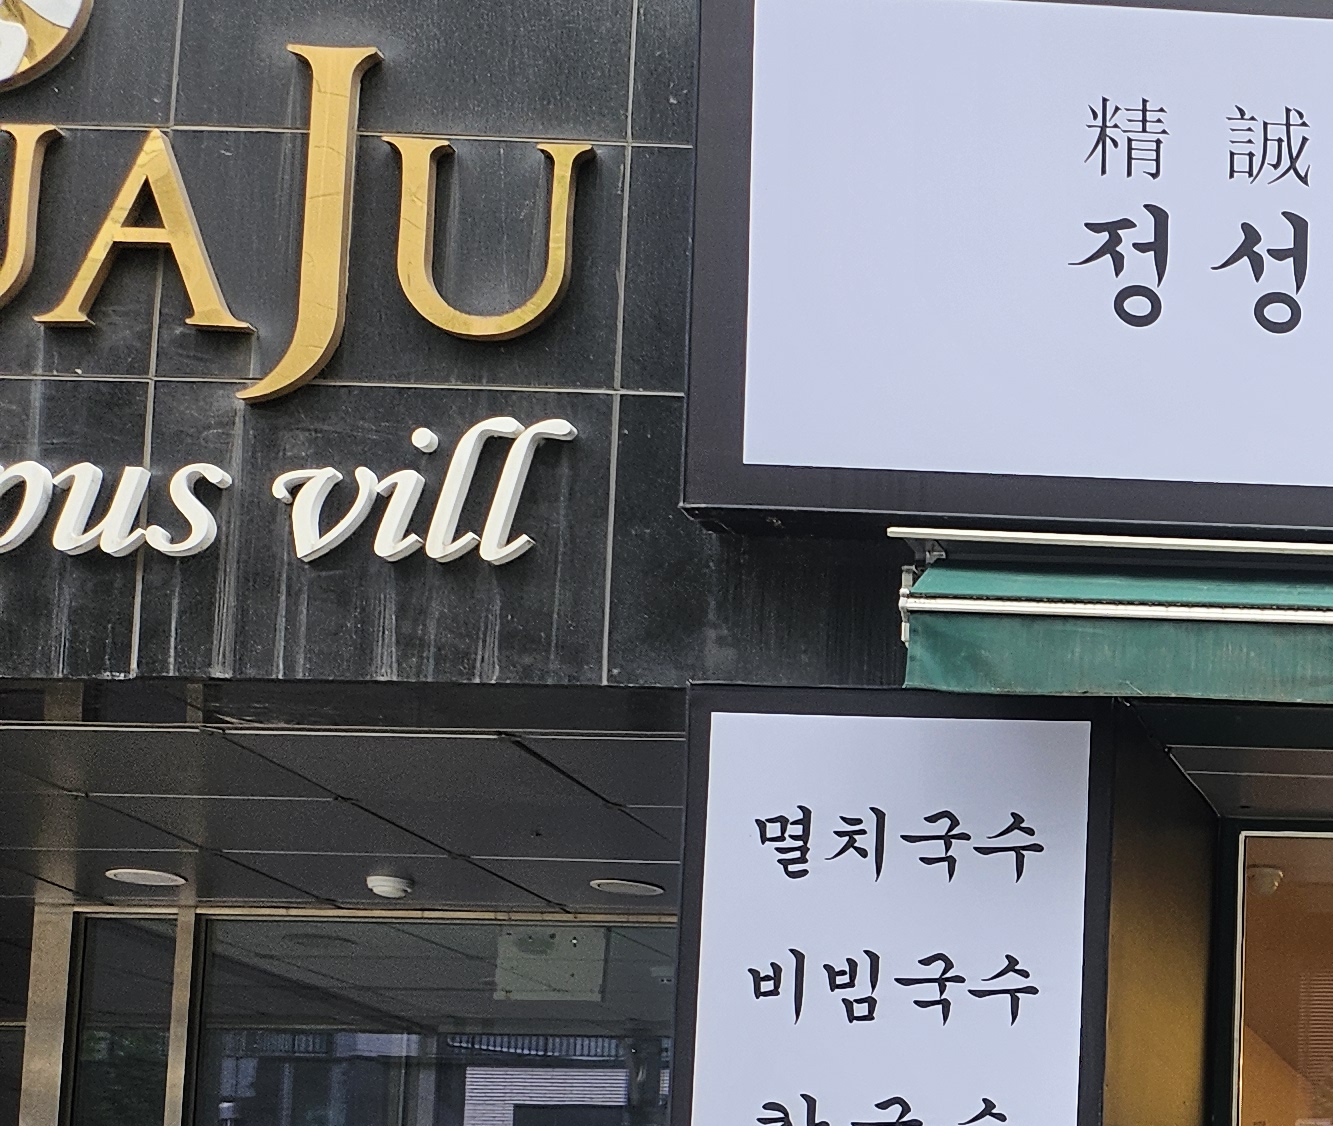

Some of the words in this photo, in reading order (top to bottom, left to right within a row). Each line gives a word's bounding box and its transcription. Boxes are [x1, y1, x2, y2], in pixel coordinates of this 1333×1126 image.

[1084, 95, 1311, 187] 精誠
[1068, 203, 1309, 334] 정성
[272, 415, 579, 567] vill
[755, 804, 1045, 884] 멸치국수
[747, 948, 1040, 1027] 비빔국수
